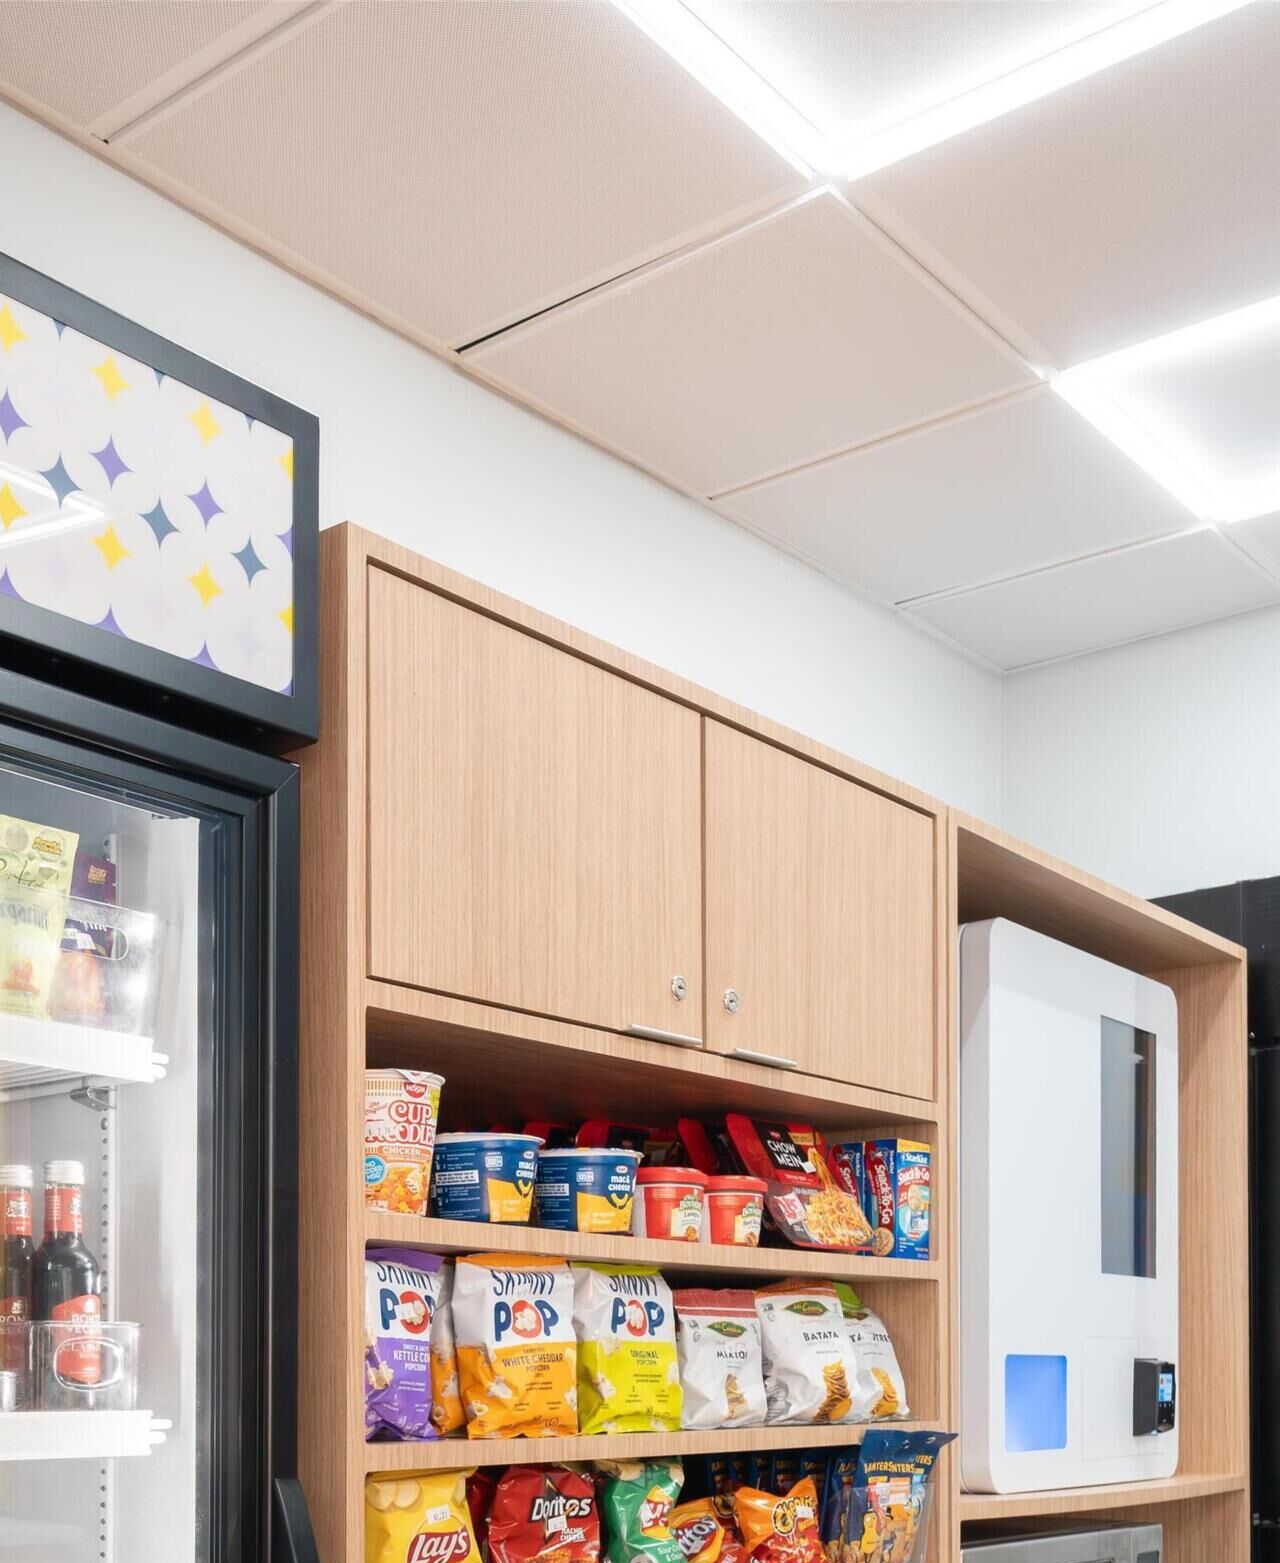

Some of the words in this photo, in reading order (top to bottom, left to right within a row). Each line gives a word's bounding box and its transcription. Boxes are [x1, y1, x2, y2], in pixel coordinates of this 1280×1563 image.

[388, 1100, 433, 1125] CUP
[383, 1147, 421, 1156] CHICKEN
[767, 1139, 797, 1154] CHOW
[775, 1153, 804, 1168] MEIN
[376, 1260, 433, 1292] SKINNY
[489, 1269, 556, 1297] SKINNY
[608, 1274, 658, 1297] SKINNY
[494, 1299, 560, 1342] POP
[611, 1297, 665, 1337] POP
[803, 1331, 840, 1342] BATATA
[393, 1350, 419, 1361] KETTLE
[502, 1356, 531, 1368] WHITE
[532, 1353, 564, 1364] CHEDDAR
[631, 1350, 659, 1360] ORIGINAL
[636, 1358, 658, 1366] POPCORN
[404, 1362, 427, 1372] POPCORN
[525, 1363, 550, 1373] POPCORN
[531, 1497, 592, 1521] Doritos
[561, 1527, 583, 1536] NACHO
